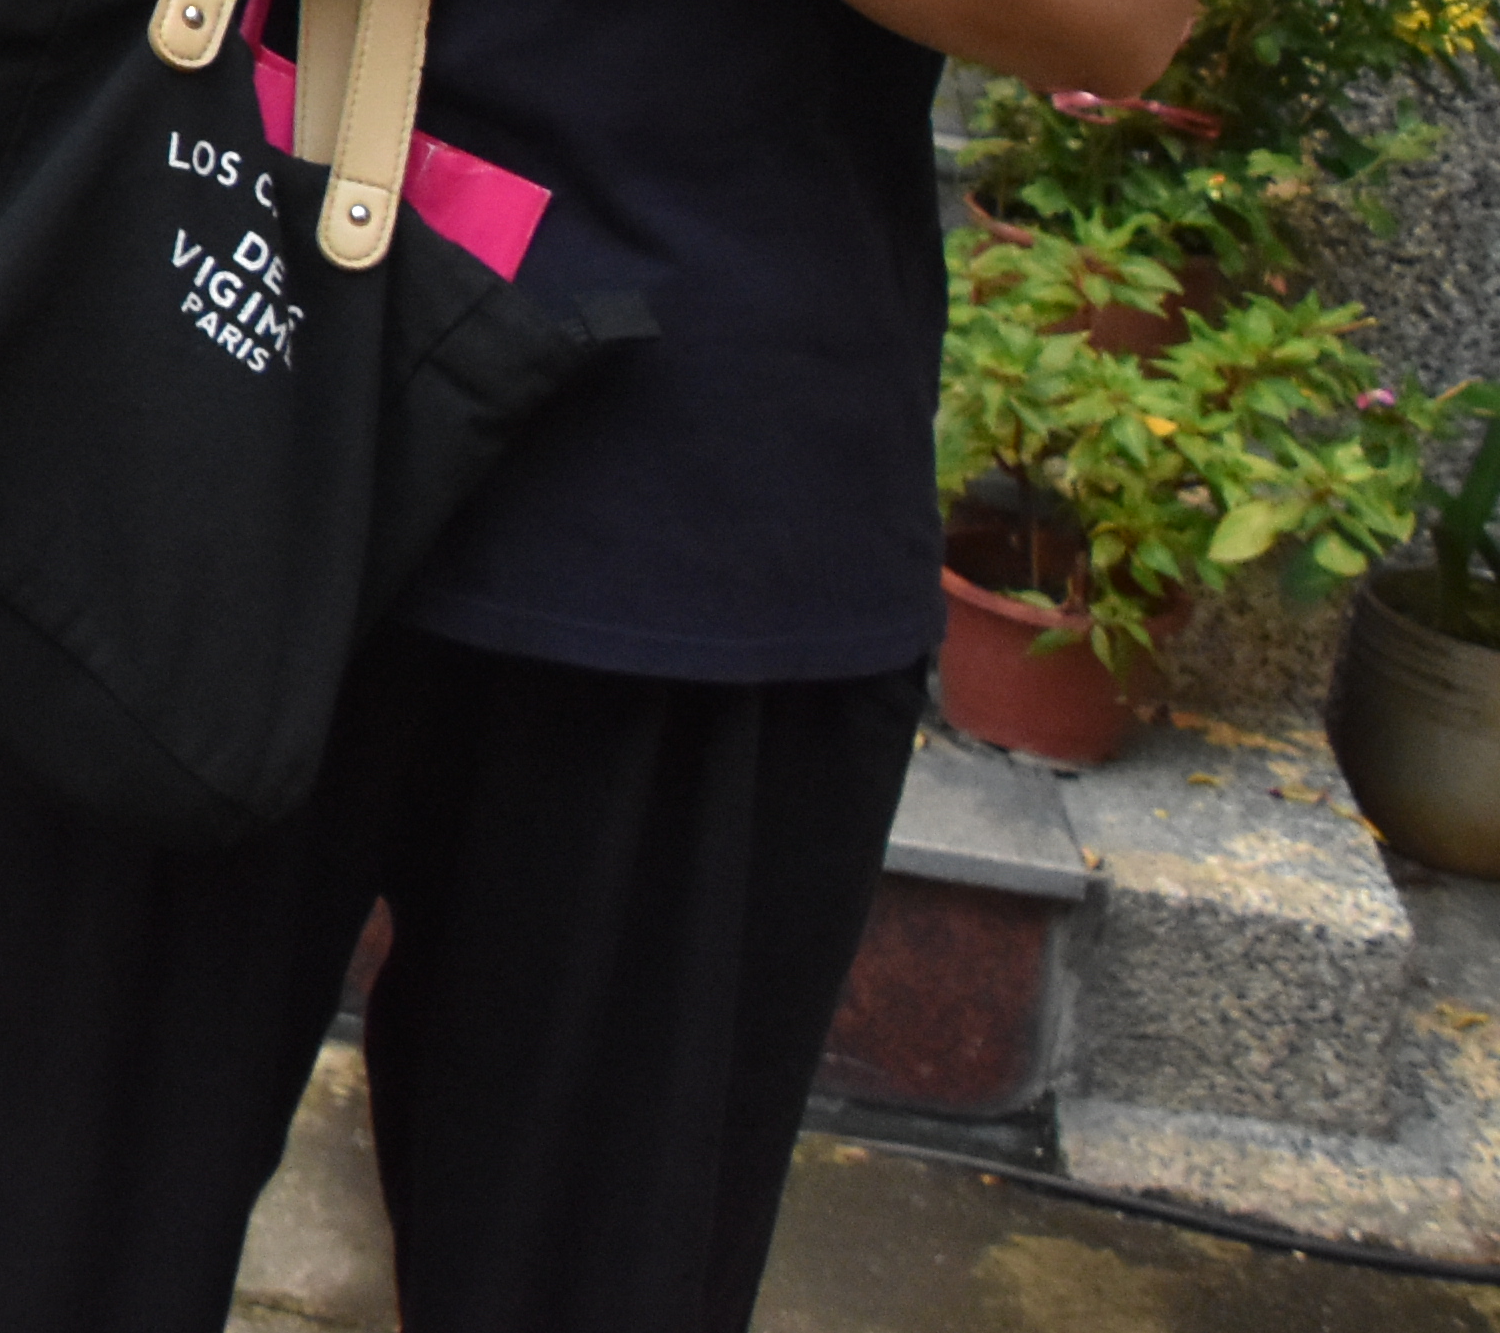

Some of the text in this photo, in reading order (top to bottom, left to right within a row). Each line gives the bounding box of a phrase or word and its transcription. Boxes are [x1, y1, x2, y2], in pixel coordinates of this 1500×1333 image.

[168, 131, 242, 187] LOS
[171, 228, 292, 367] VIGIM
[232, 230, 285, 296] DE
[180, 290, 270, 373] PARIS
